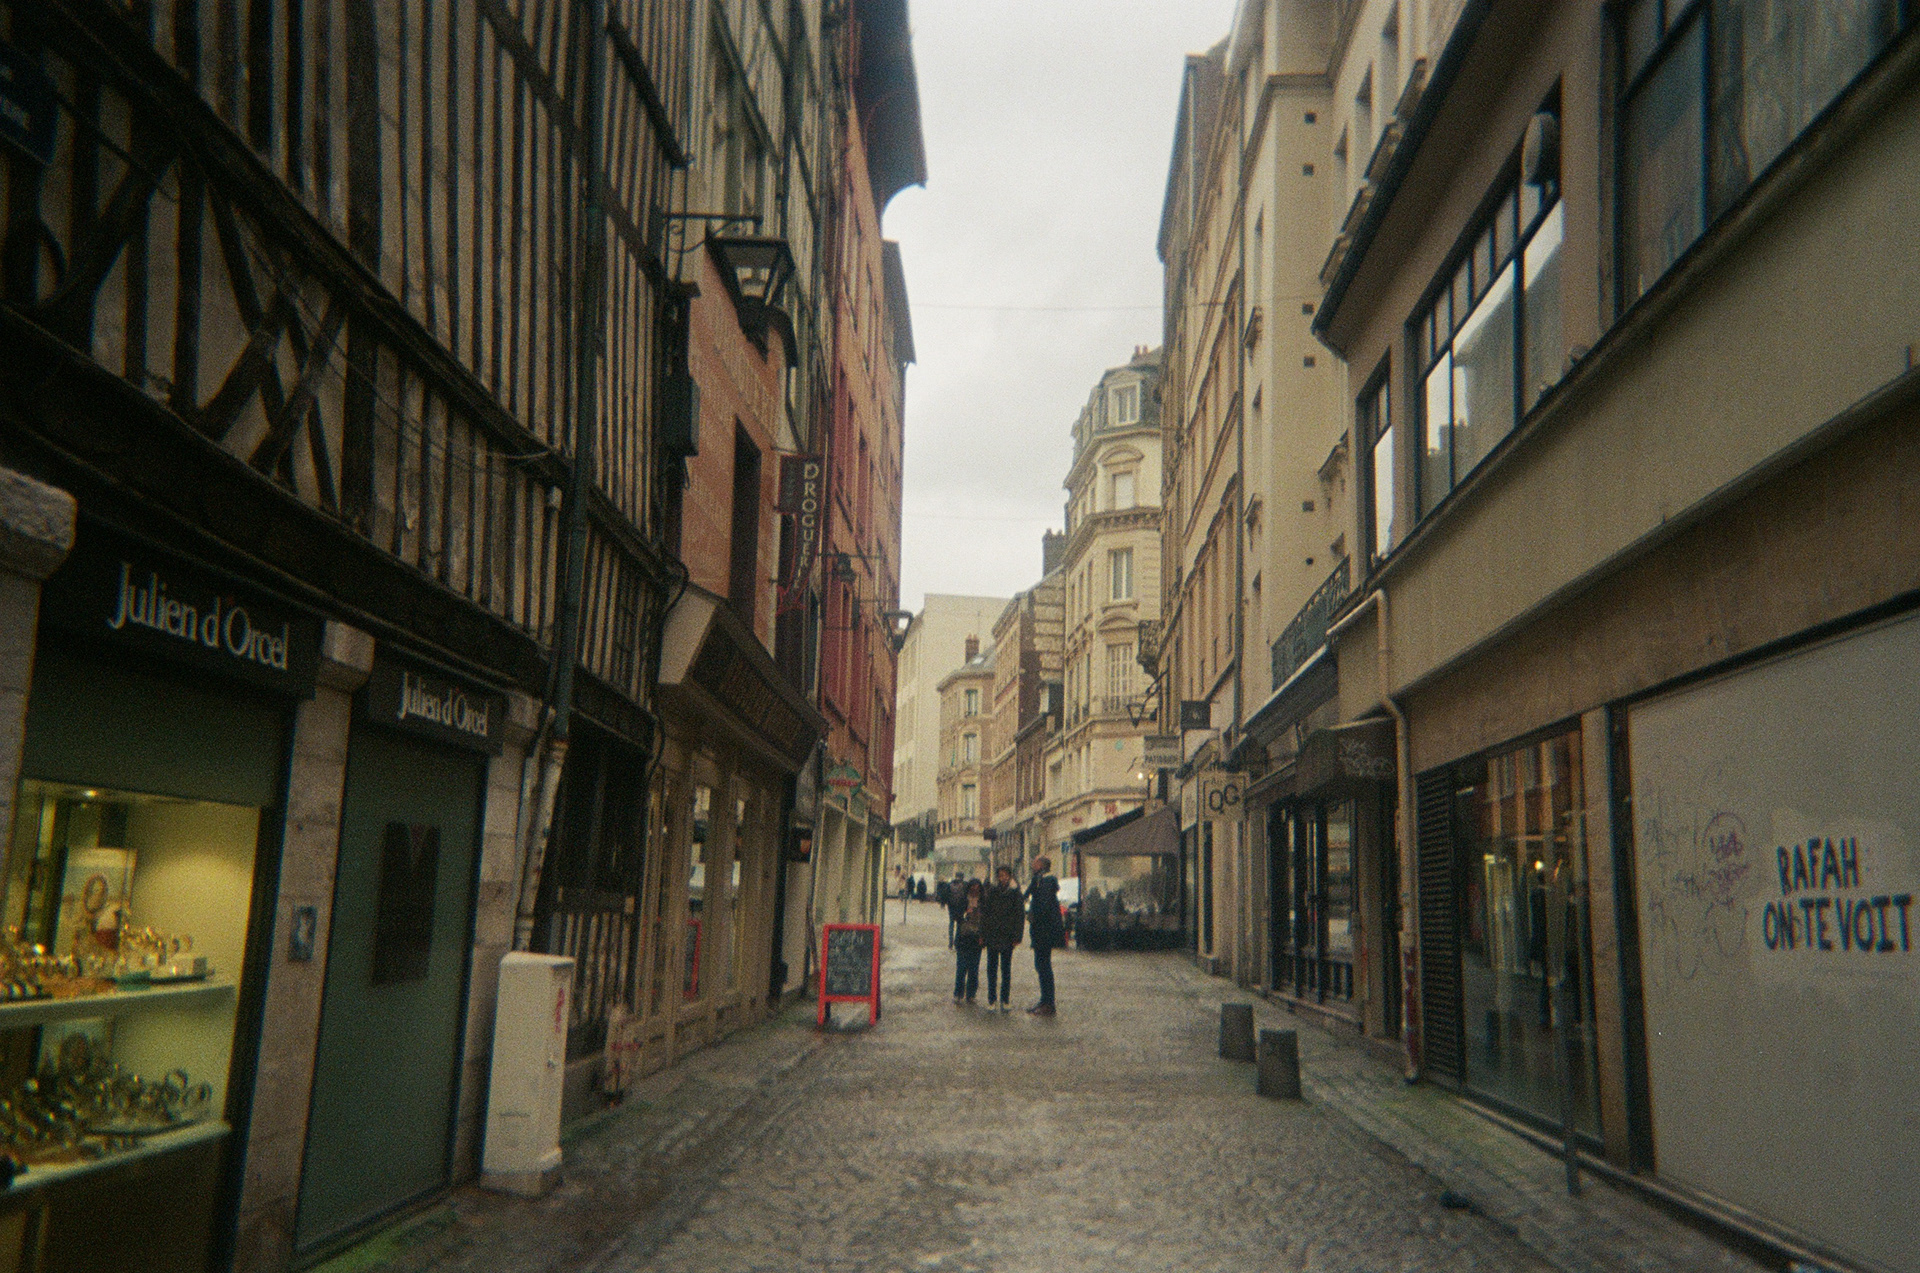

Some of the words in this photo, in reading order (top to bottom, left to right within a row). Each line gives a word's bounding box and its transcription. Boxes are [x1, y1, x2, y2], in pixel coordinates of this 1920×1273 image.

[793, 464, 819, 589] DROGUERIE
[108, 562, 198, 641] Julien
[397, 672, 440, 722] Julien
[1209, 784, 1240, 815] QG
[1776, 837, 1860, 896] RAFAH
[1764, 901, 1795, 951] ON
[1799, 898, 1833, 951] TE
[1836, 895, 1913, 952] VOIT
